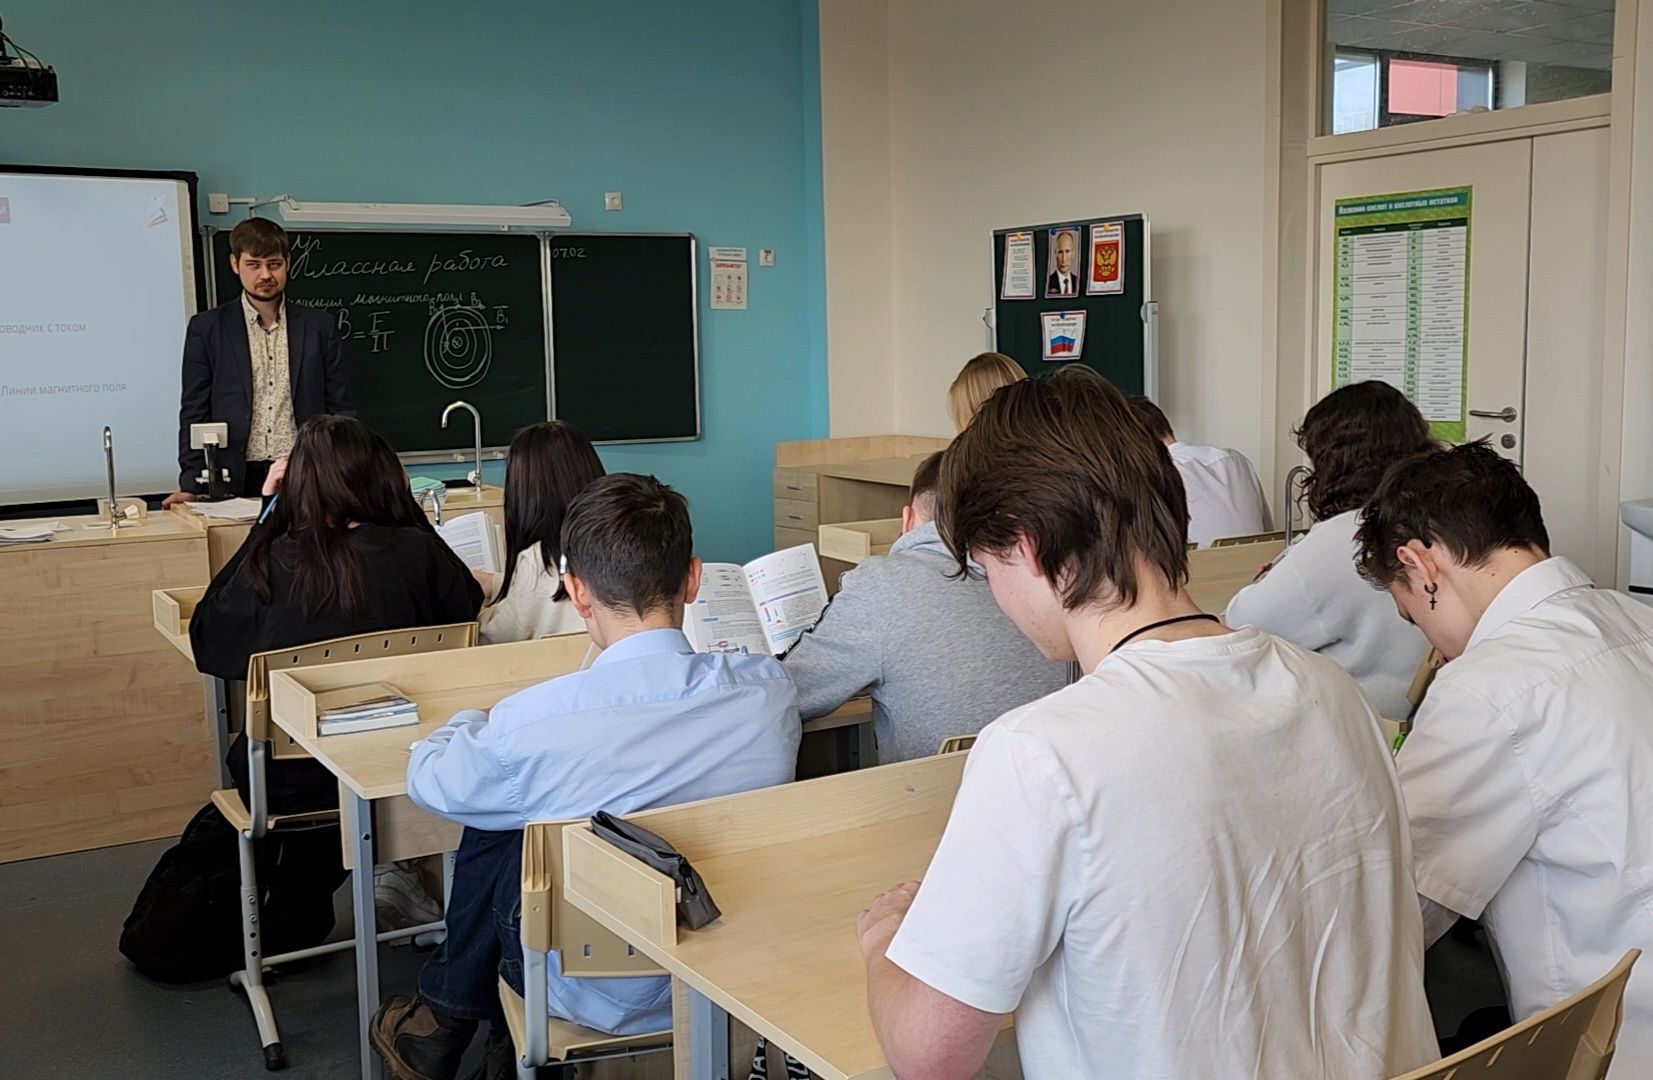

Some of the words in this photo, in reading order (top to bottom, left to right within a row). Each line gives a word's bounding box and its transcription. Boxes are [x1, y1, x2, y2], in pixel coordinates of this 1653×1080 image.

[552, 247, 587, 259] 07.02
[423, 250, 509, 285] работа
[47, 323, 54, 333] с
[55, 323, 87, 333] током
[1, 385, 37, 397] Линии
[39, 384, 100, 395] магнитного
[102, 383, 127, 393] поля
